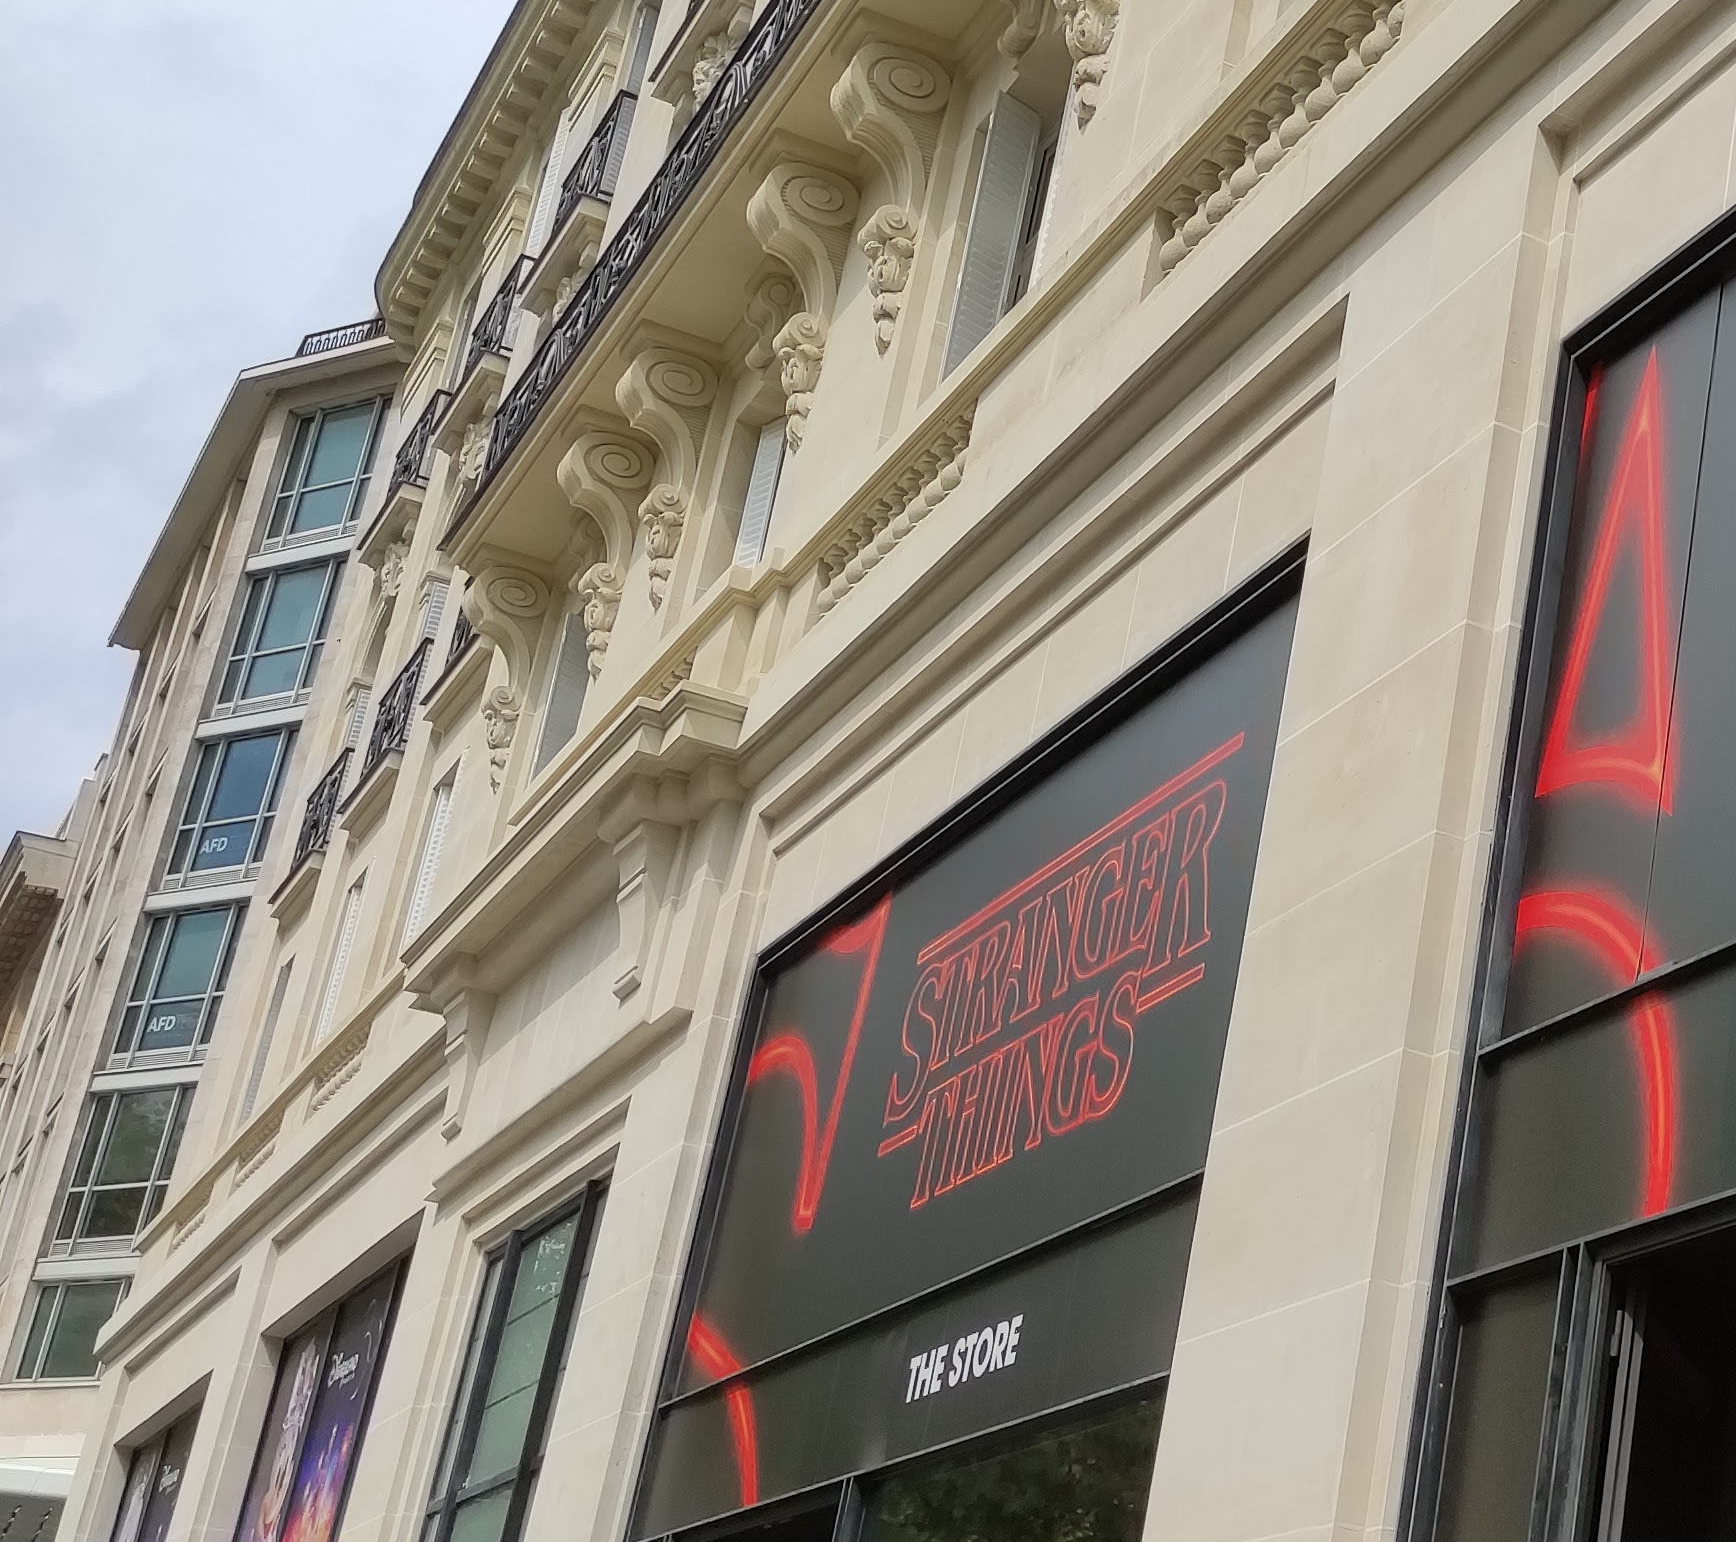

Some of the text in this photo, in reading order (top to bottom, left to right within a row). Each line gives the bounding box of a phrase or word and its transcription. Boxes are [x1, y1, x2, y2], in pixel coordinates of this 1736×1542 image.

[199, 837, 228, 854] AFD
[882, 778, 1228, 1127] STRANGER
[146, 1015, 176, 1033] AFD
[910, 970, 1135, 1209] THINGS
[905, 1313, 1024, 1404] THE STORE
